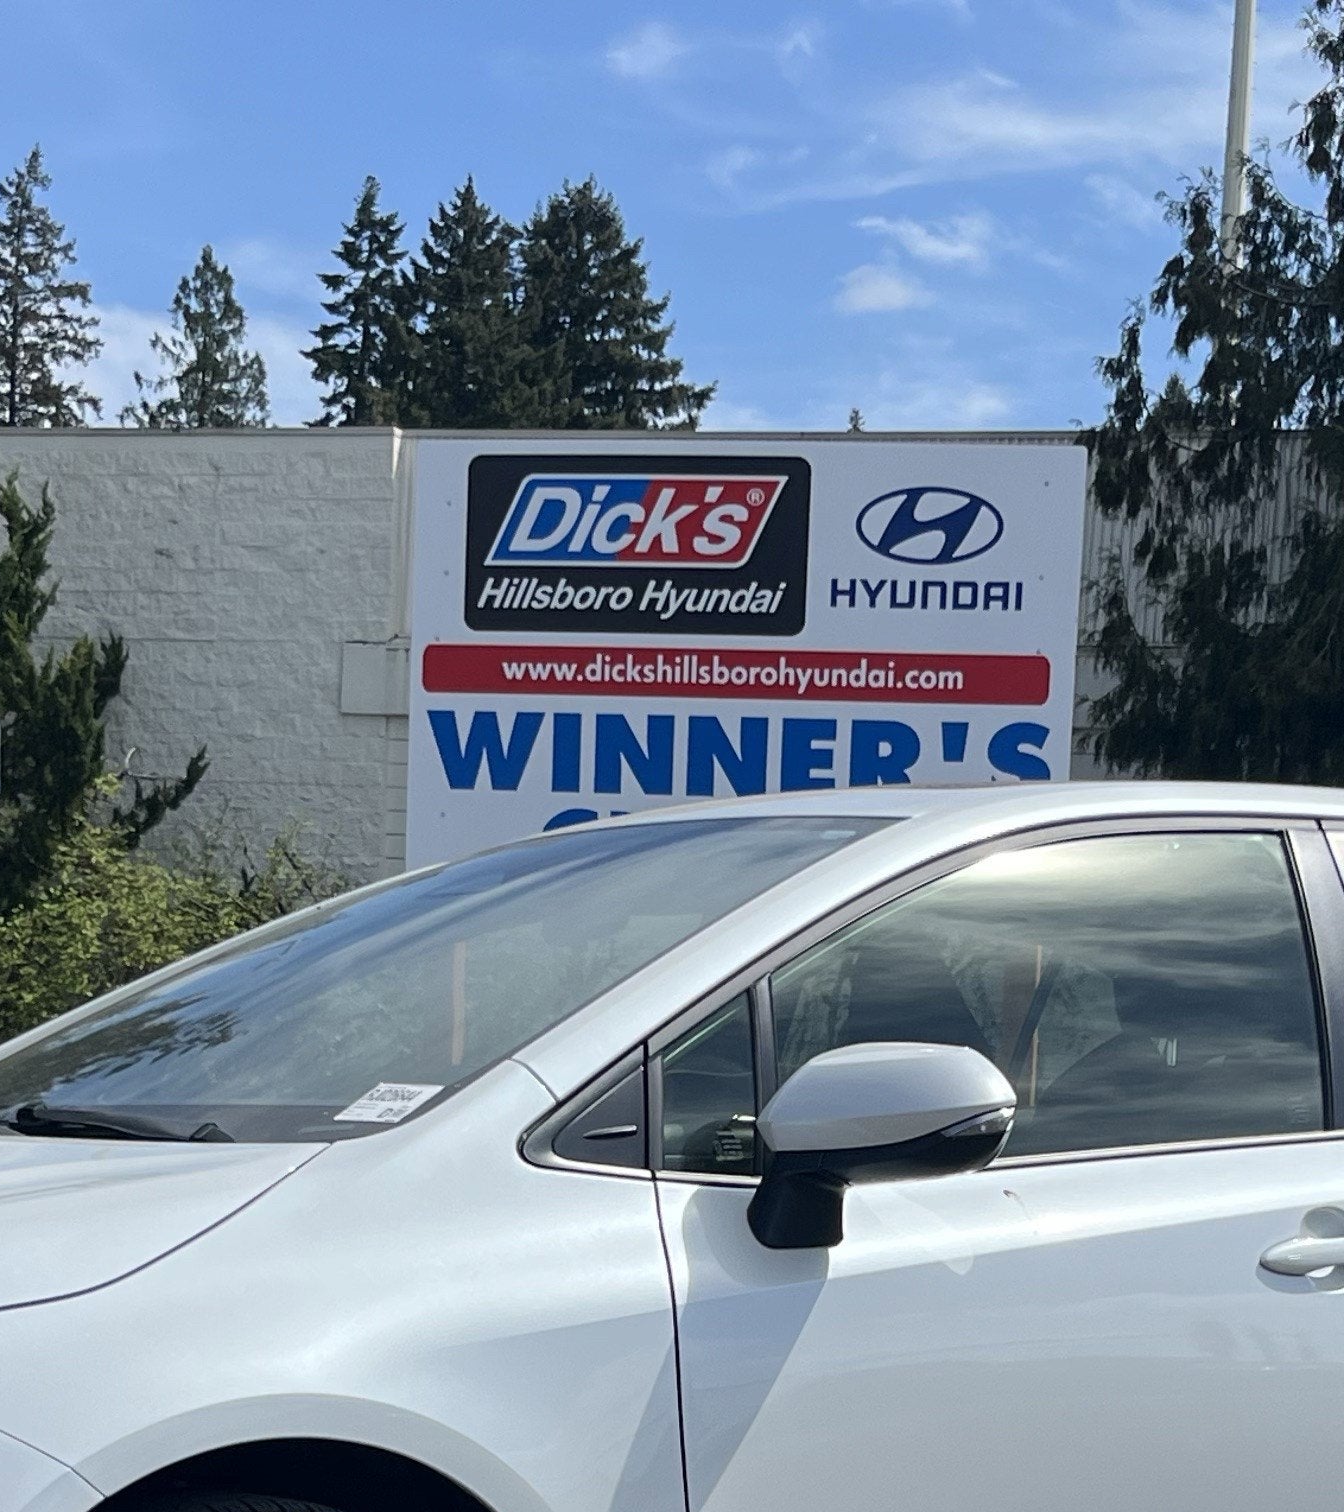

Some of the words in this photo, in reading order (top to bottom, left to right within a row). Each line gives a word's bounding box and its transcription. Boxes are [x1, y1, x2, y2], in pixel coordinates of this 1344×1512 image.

[508, 484, 749, 556] Dick's
[477, 577, 634, 611] Hillsboro
[639, 580, 787, 620] Hyundai
[830, 577, 1023, 612] HYUNDAI
[501, 654, 964, 695] www.dickshillsborohyundai.com
[427, 710, 1052, 798] WINNER'S
